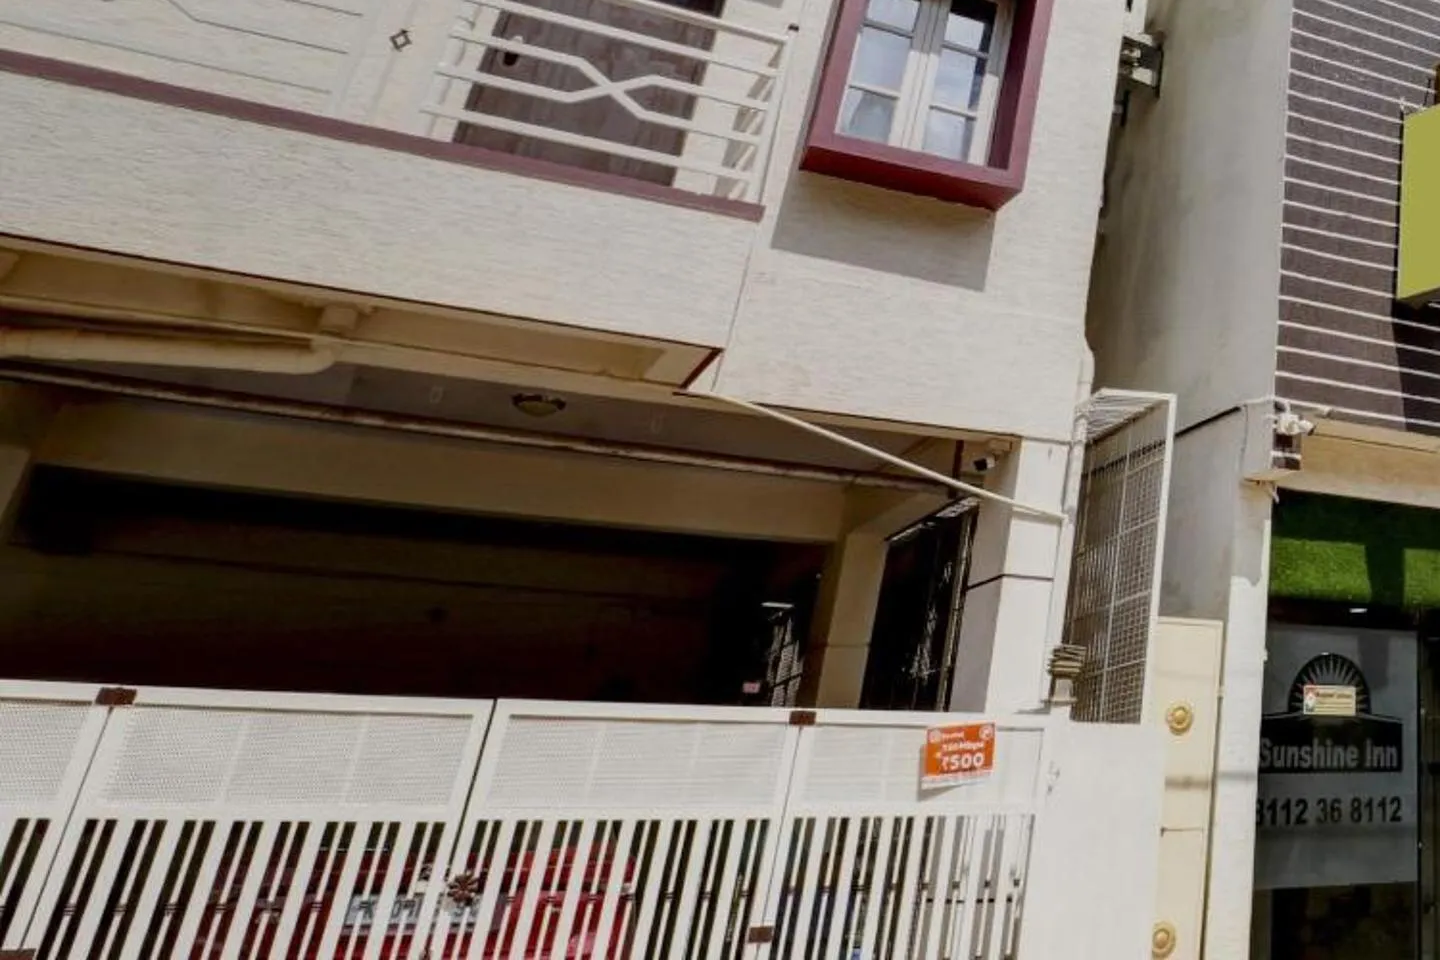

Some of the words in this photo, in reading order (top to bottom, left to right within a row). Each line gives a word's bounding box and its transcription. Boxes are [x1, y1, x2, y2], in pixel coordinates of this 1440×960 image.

[1260, 738, 1358, 768] Sunshine
[1365, 738, 1398, 768] Inn
[1316, 798, 1342, 823] 36
[1350, 796, 1403, 823] 8112
